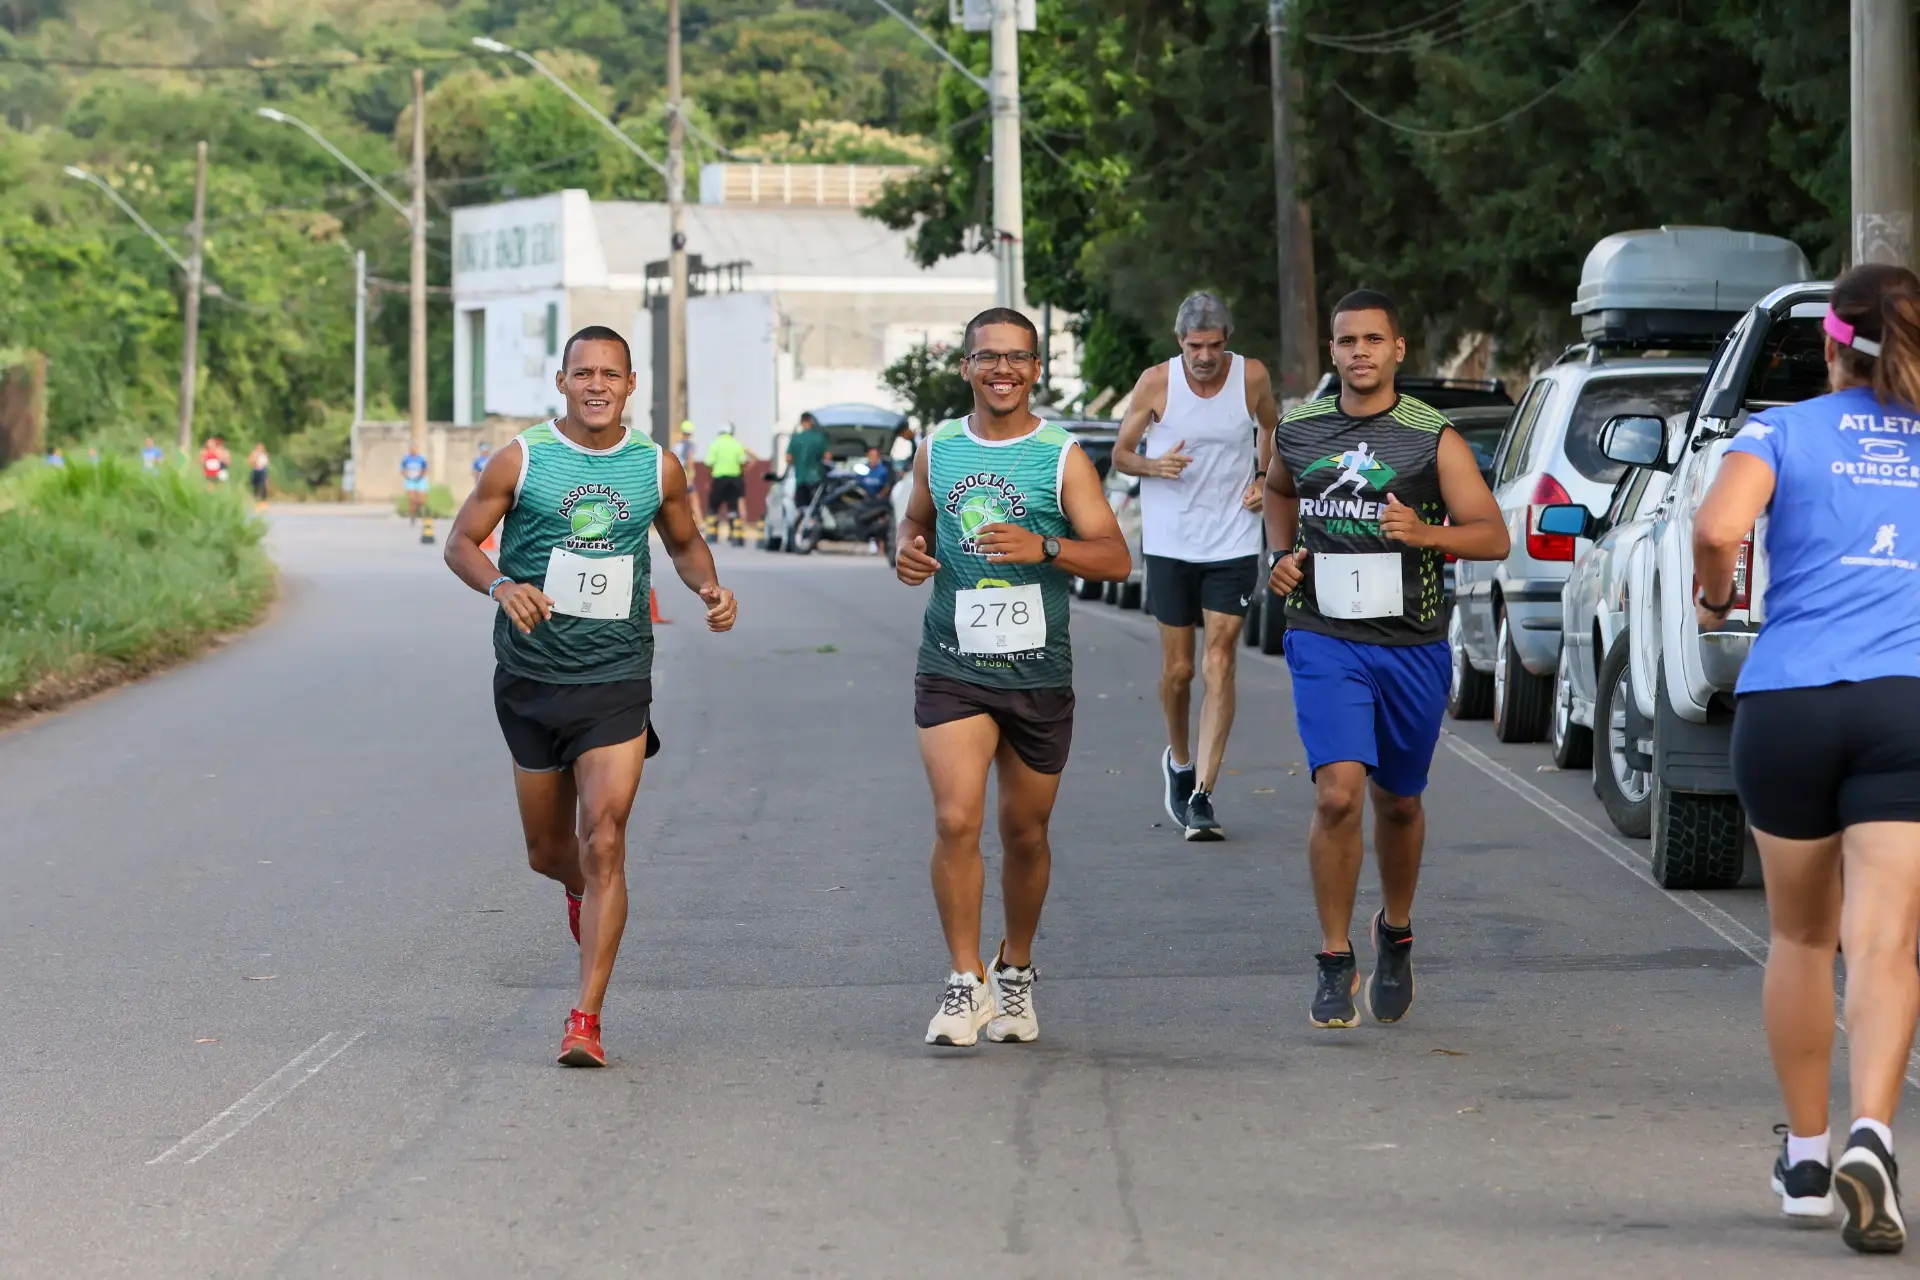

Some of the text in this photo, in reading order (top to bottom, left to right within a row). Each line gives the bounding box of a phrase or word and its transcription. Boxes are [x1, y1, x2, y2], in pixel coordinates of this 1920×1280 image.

[558, 483, 630, 520] ASSOCIAÇÃO
[945, 472, 1026, 517] ASSOCIAÇÃO
[566, 541, 614, 551] VIAGENS
[577, 572, 608, 595] 19
[1350, 569, 1360, 593] 1
[970, 601, 1029, 628] 278
